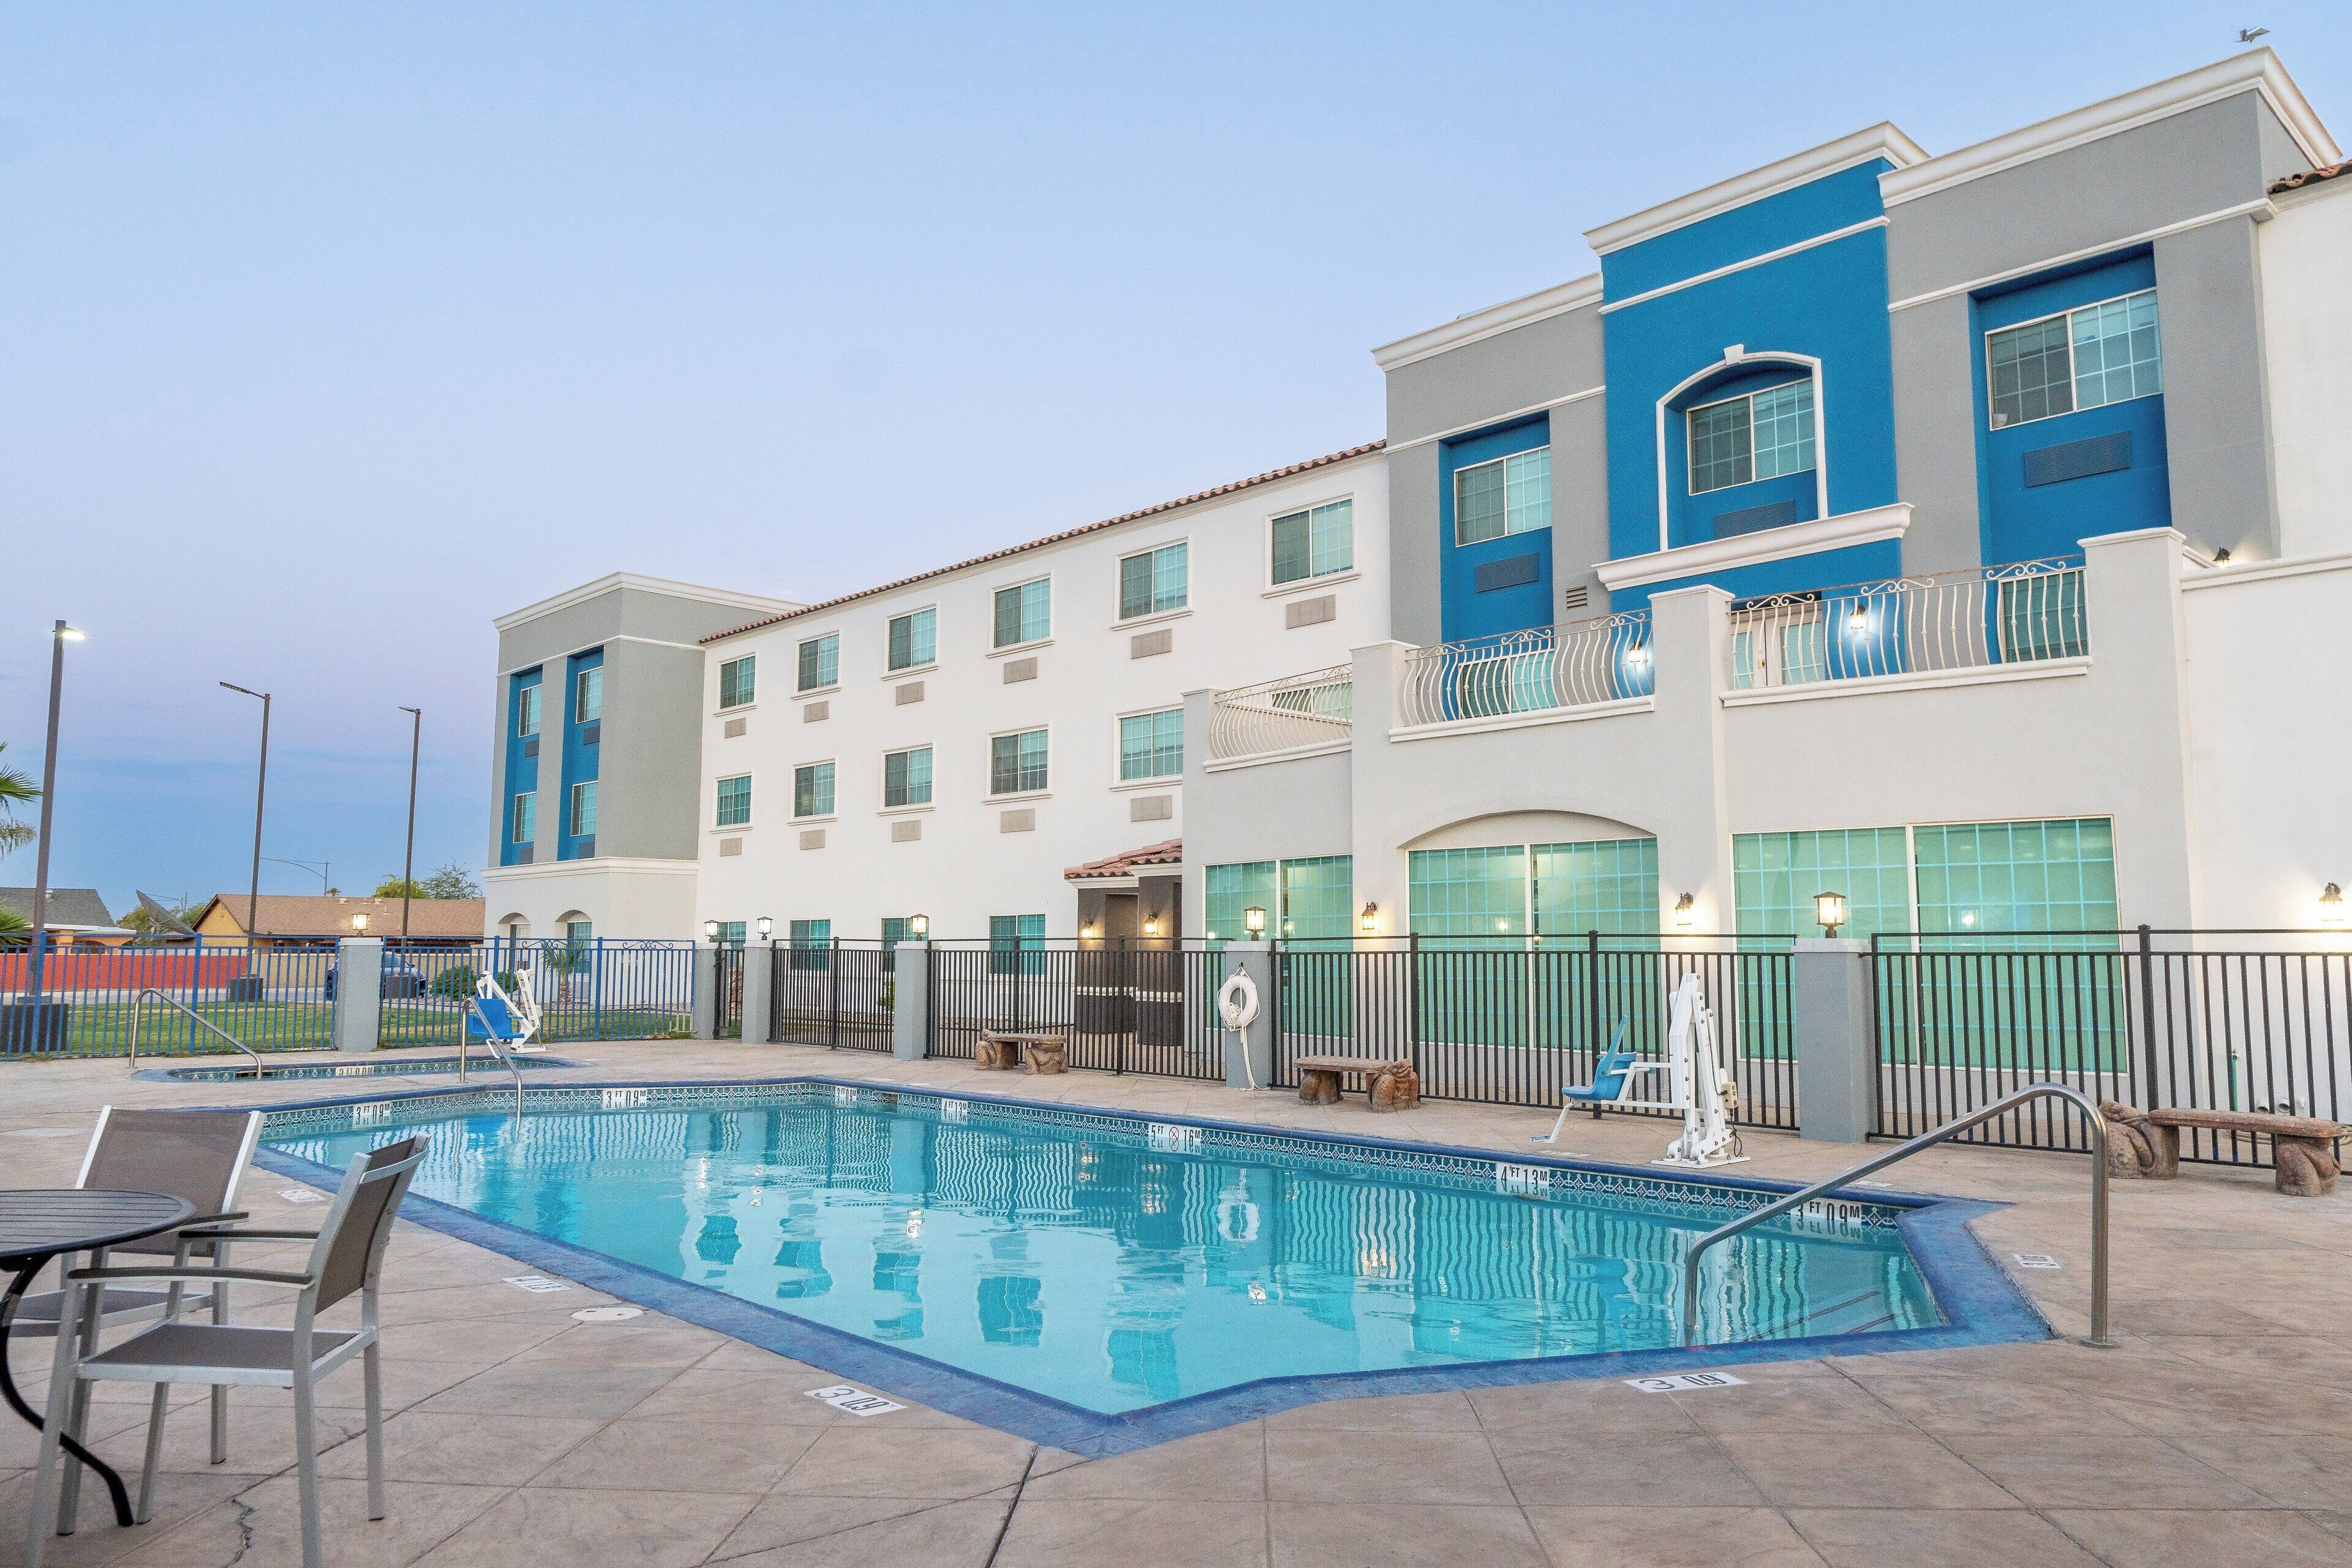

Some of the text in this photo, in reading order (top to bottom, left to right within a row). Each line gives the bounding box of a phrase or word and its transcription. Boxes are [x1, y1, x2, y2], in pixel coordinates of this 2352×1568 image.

[1157, 1125, 1164, 1134] FT
[1501, 1166, 1507, 1180] 4
[1510, 1166, 1520, 1178] FT
[1809, 1201, 1821, 1214] FT
[1638, 1379, 1675, 1390] 3
[813, 1388, 856, 1398] 3
